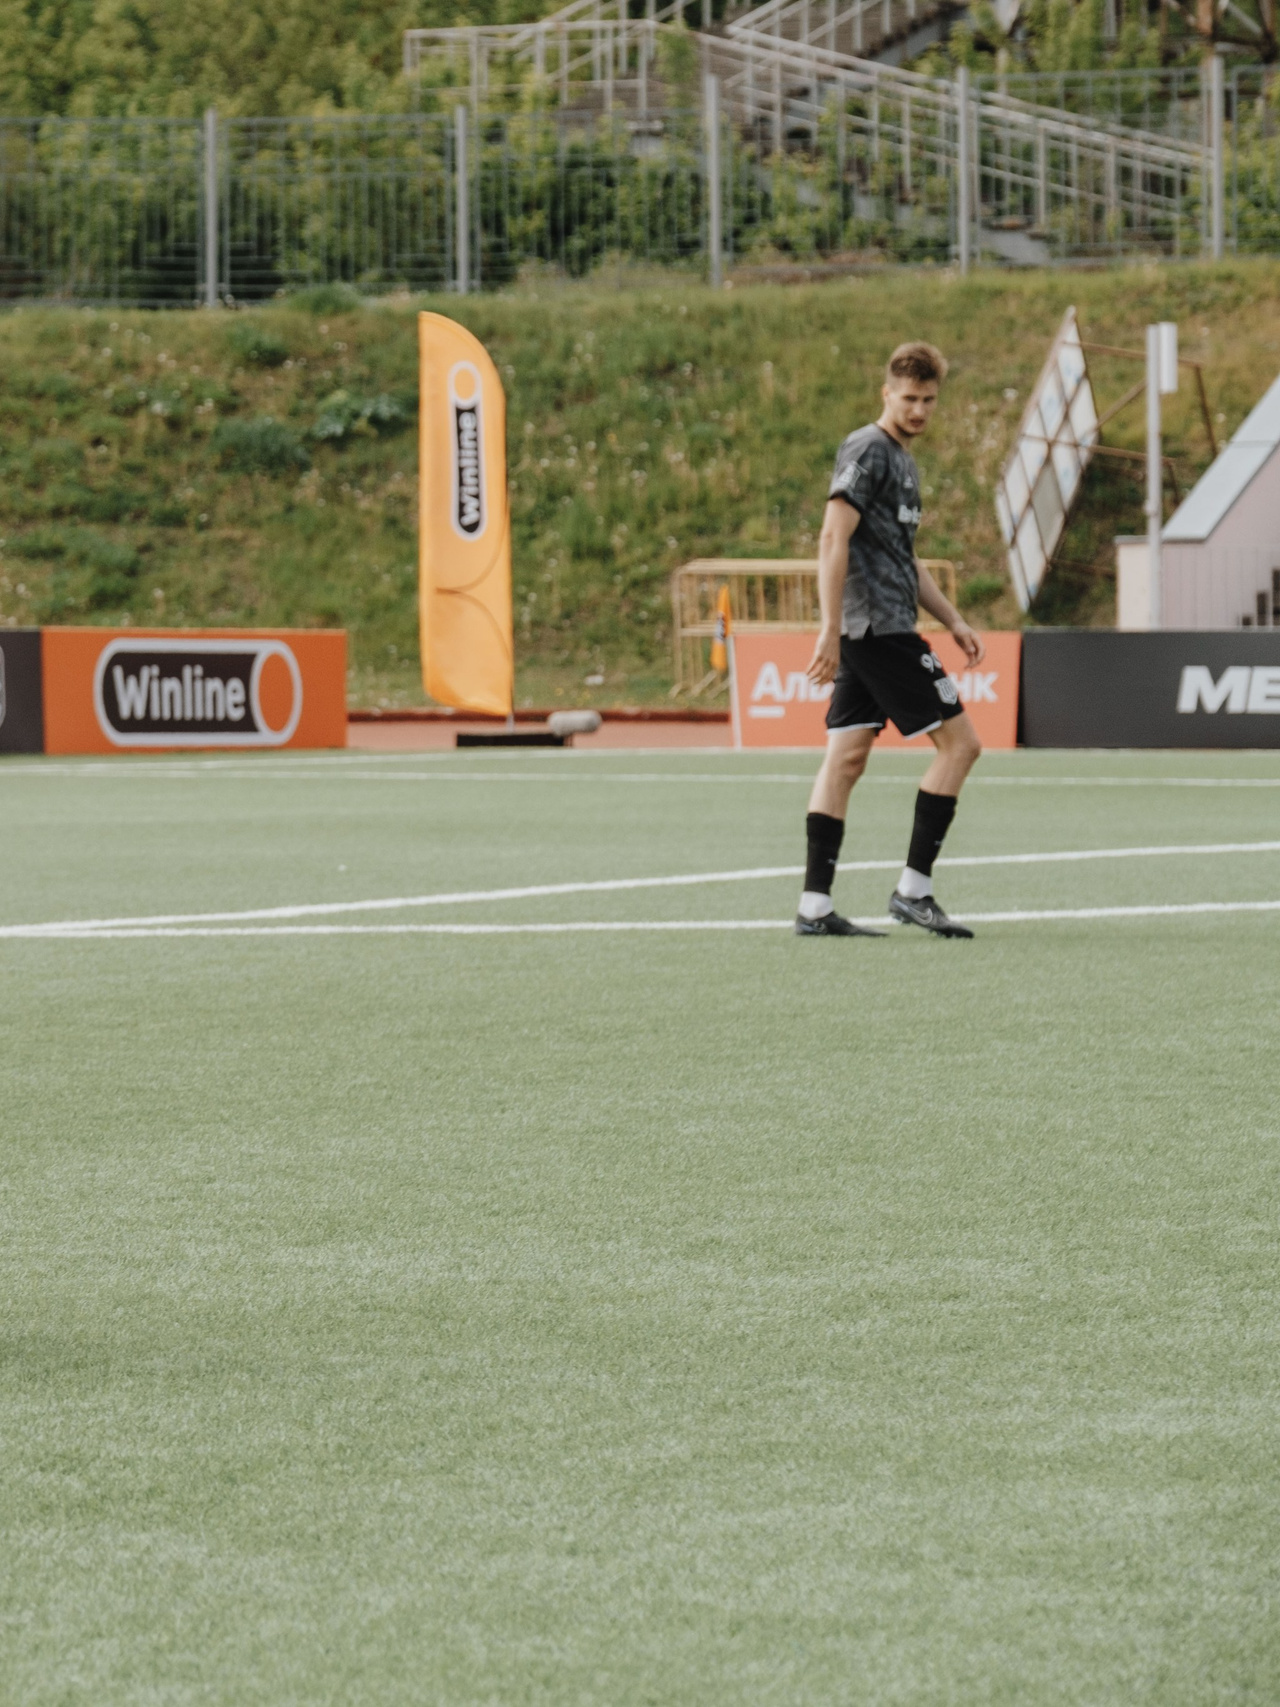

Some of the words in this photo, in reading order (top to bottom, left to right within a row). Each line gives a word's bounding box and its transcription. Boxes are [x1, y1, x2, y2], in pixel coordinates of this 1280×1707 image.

[458, 411, 480, 527] Winline
[112, 664, 246, 721] Winline
[750, 661, 835, 702] Аль
[1176, 665, 1280, 714] ME
